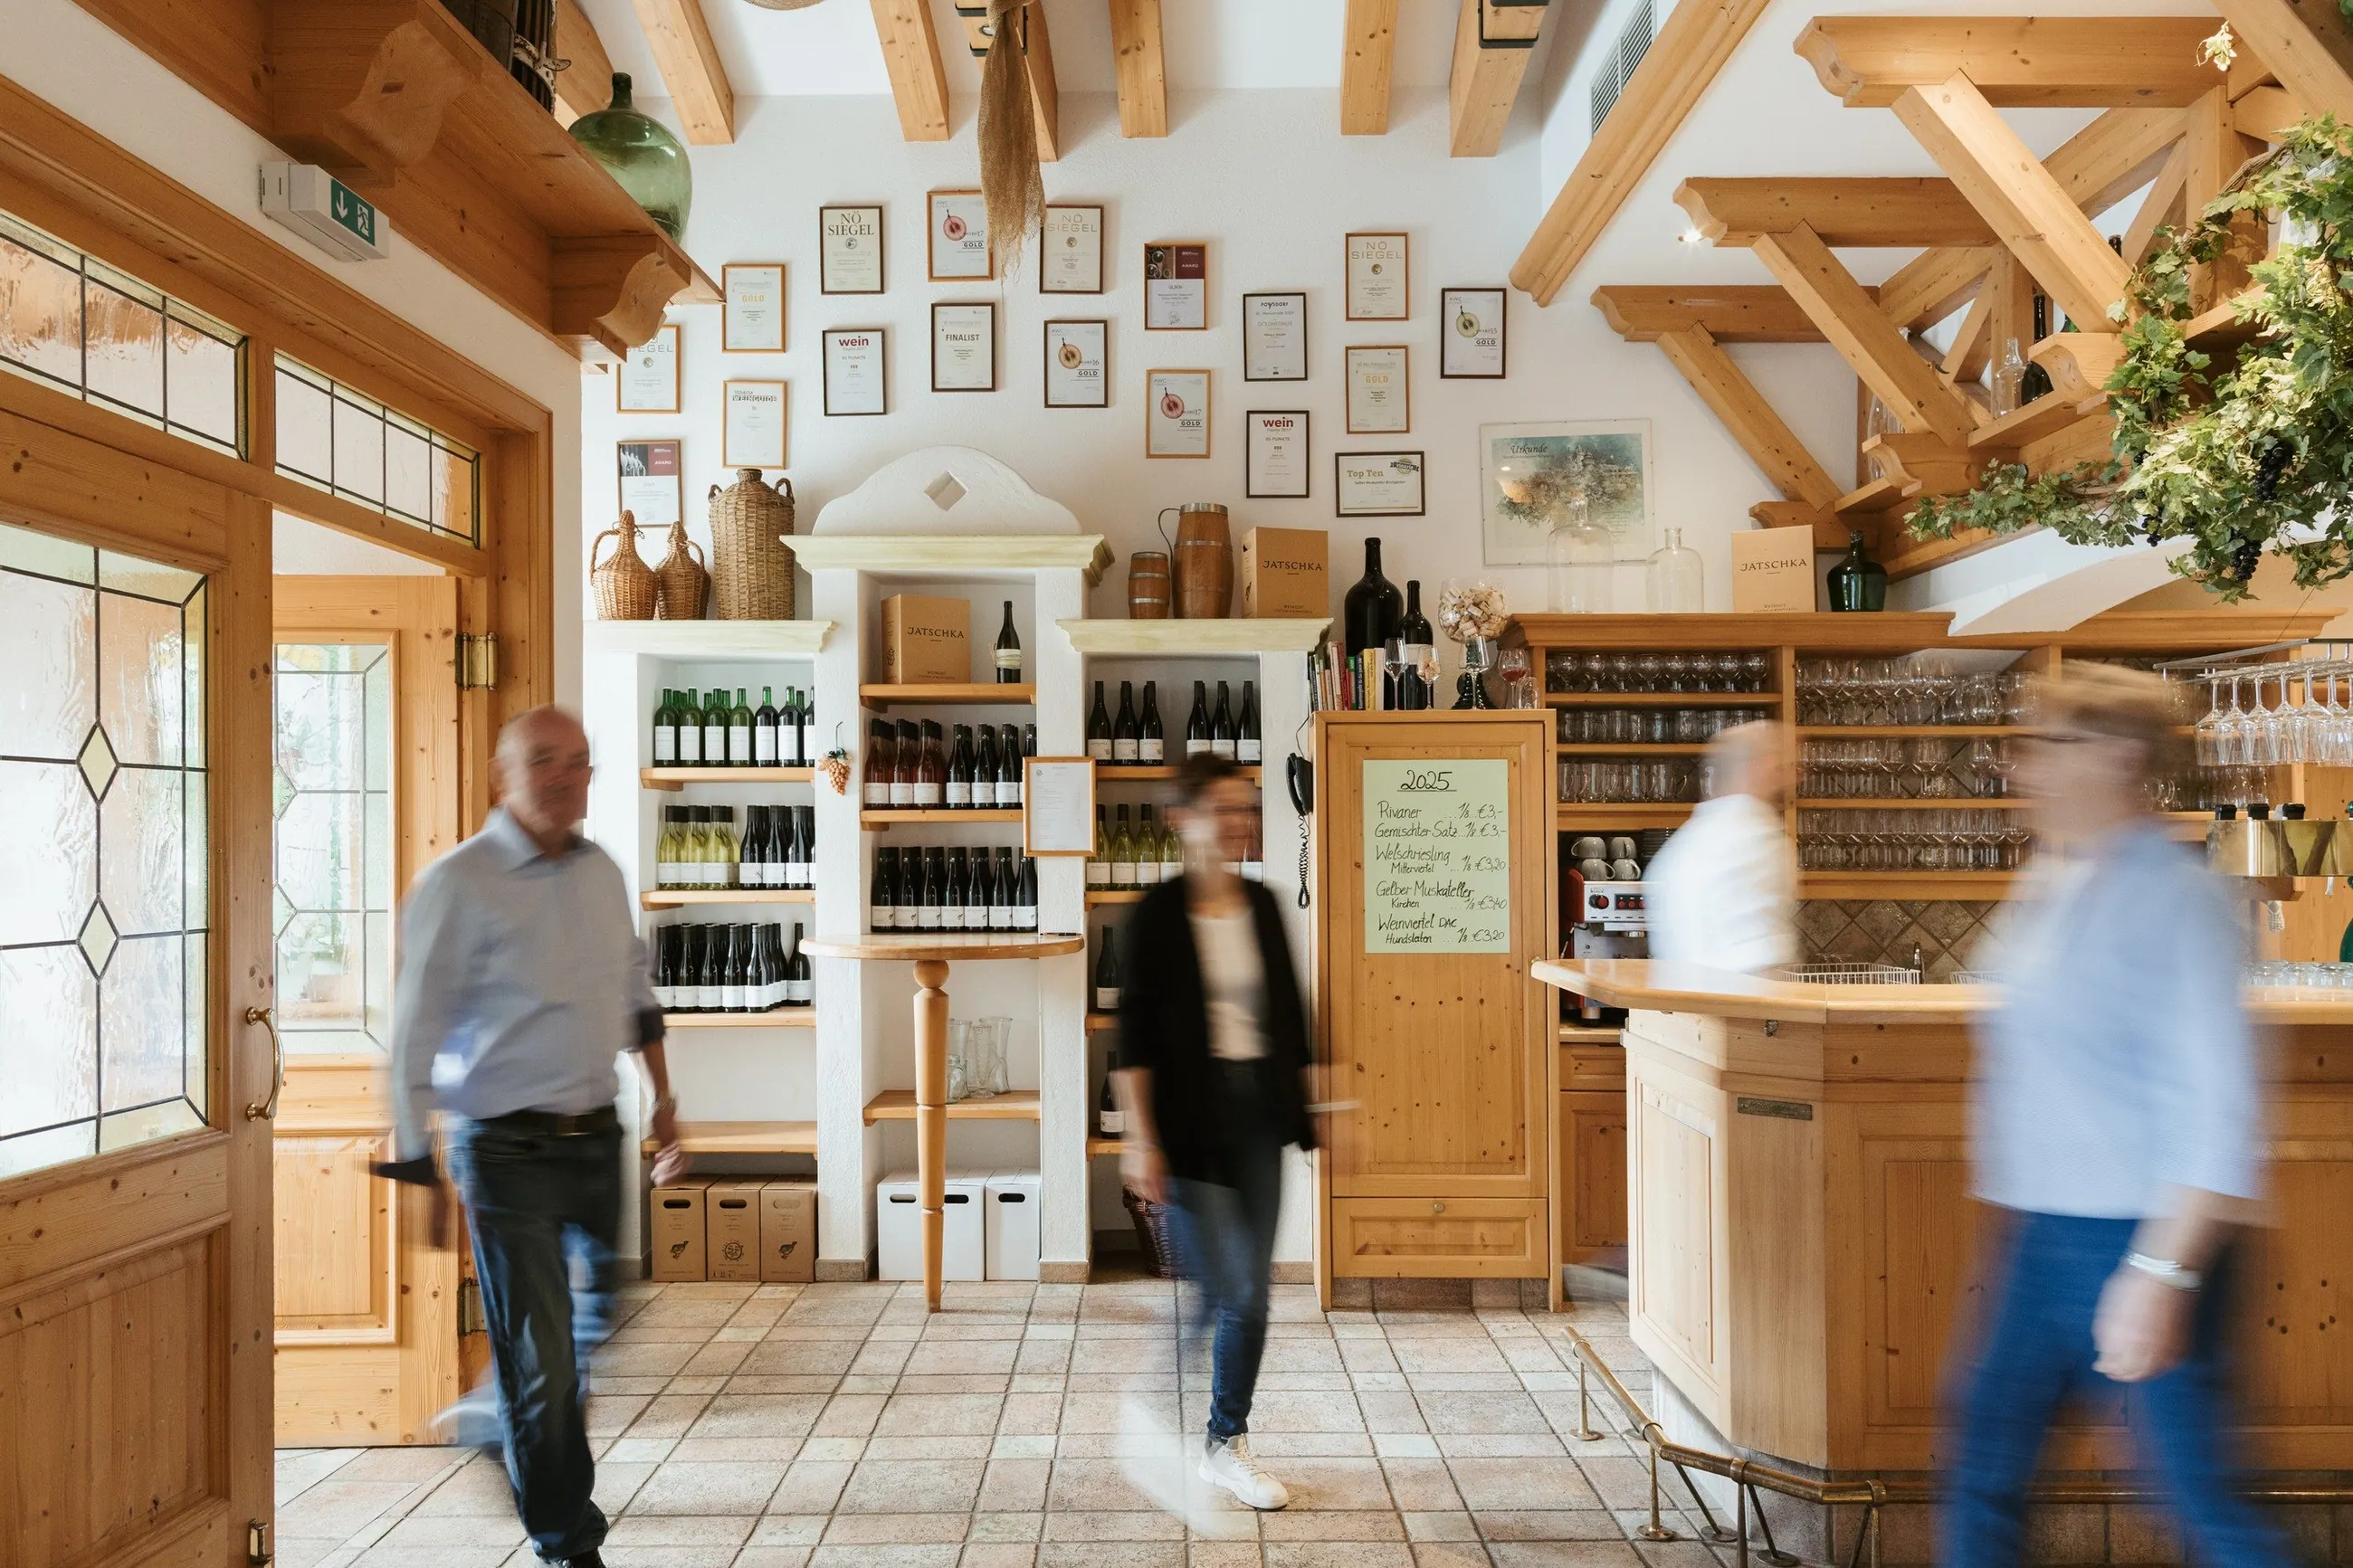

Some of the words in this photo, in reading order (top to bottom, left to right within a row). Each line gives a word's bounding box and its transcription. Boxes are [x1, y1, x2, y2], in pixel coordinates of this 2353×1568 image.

[841, 210, 862, 224] NÖ
[828, 224, 874, 235] SIEGEL
[838, 336, 869, 346] wein
[1366, 375, 1388, 384] GOLD
[1263, 416, 1294, 427] wein
[1510, 443, 1548, 454] Urkunde
[1347, 470, 1365, 480] Top
[1367, 470, 1384, 478] Ten
[1262, 561, 1323, 572] JATSCHKA
[1740, 559, 1806, 572] JATSCHKA
[907, 626, 965, 639] JATSCHKA
[1400, 769, 1453, 791] 2025
[1377, 800, 1423, 819] Rivaner
[1458, 802, 1470, 819] 1/8
[1374, 822, 1432, 838] Gemischter
[1432, 820, 1457, 838] Satz
[1465, 822, 1477, 838] 1/8
[1376, 843, 1450, 866] Welschriesling
[1391, 861, 1434, 874] Mitterviertel
[1462, 855, 1472, 872] 1/8
[1475, 856, 1506, 872] €3,20
[1377, 879, 1412, 897] Gelber
[1414, 879, 1475, 898] Muskateller
[1464, 898, 1475, 910] 1/8
[1478, 896, 1508, 910] €3,40
[1378, 912, 1435, 931] Weinviertel
[1439, 917, 1457, 928] DAC
[1457, 927, 1468, 943] 1/8
[1472, 928, 1505, 942] €3,20
